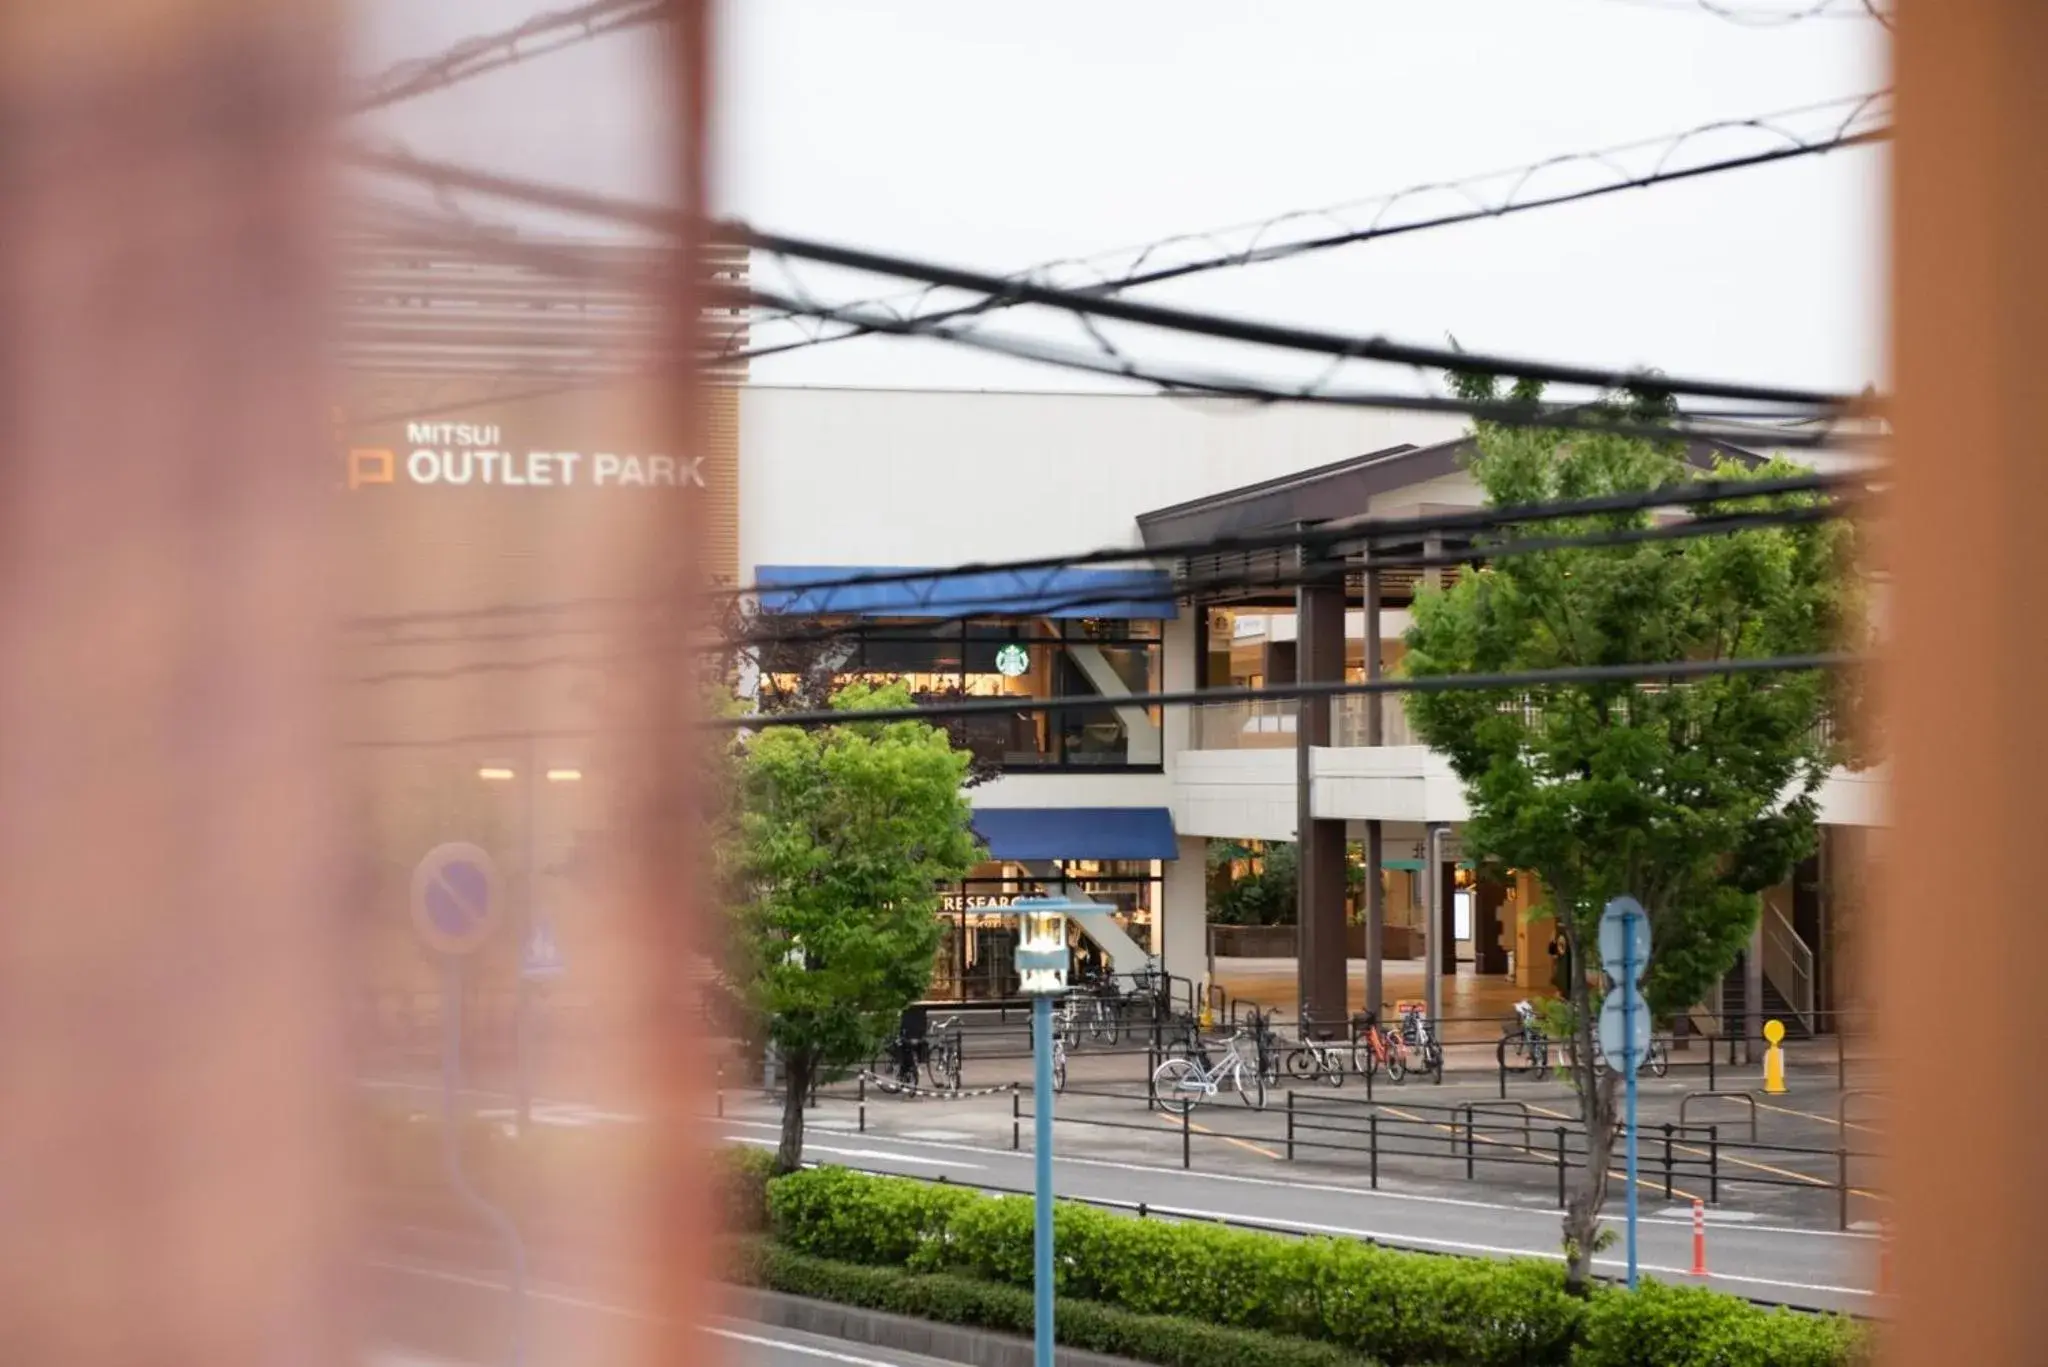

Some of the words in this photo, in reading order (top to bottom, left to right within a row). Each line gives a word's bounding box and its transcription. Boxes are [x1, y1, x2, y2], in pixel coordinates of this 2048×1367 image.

[406, 421, 500, 446] MITSUI
[406, 449, 581, 485] OUTLET
[593, 452, 706, 488] PARK
